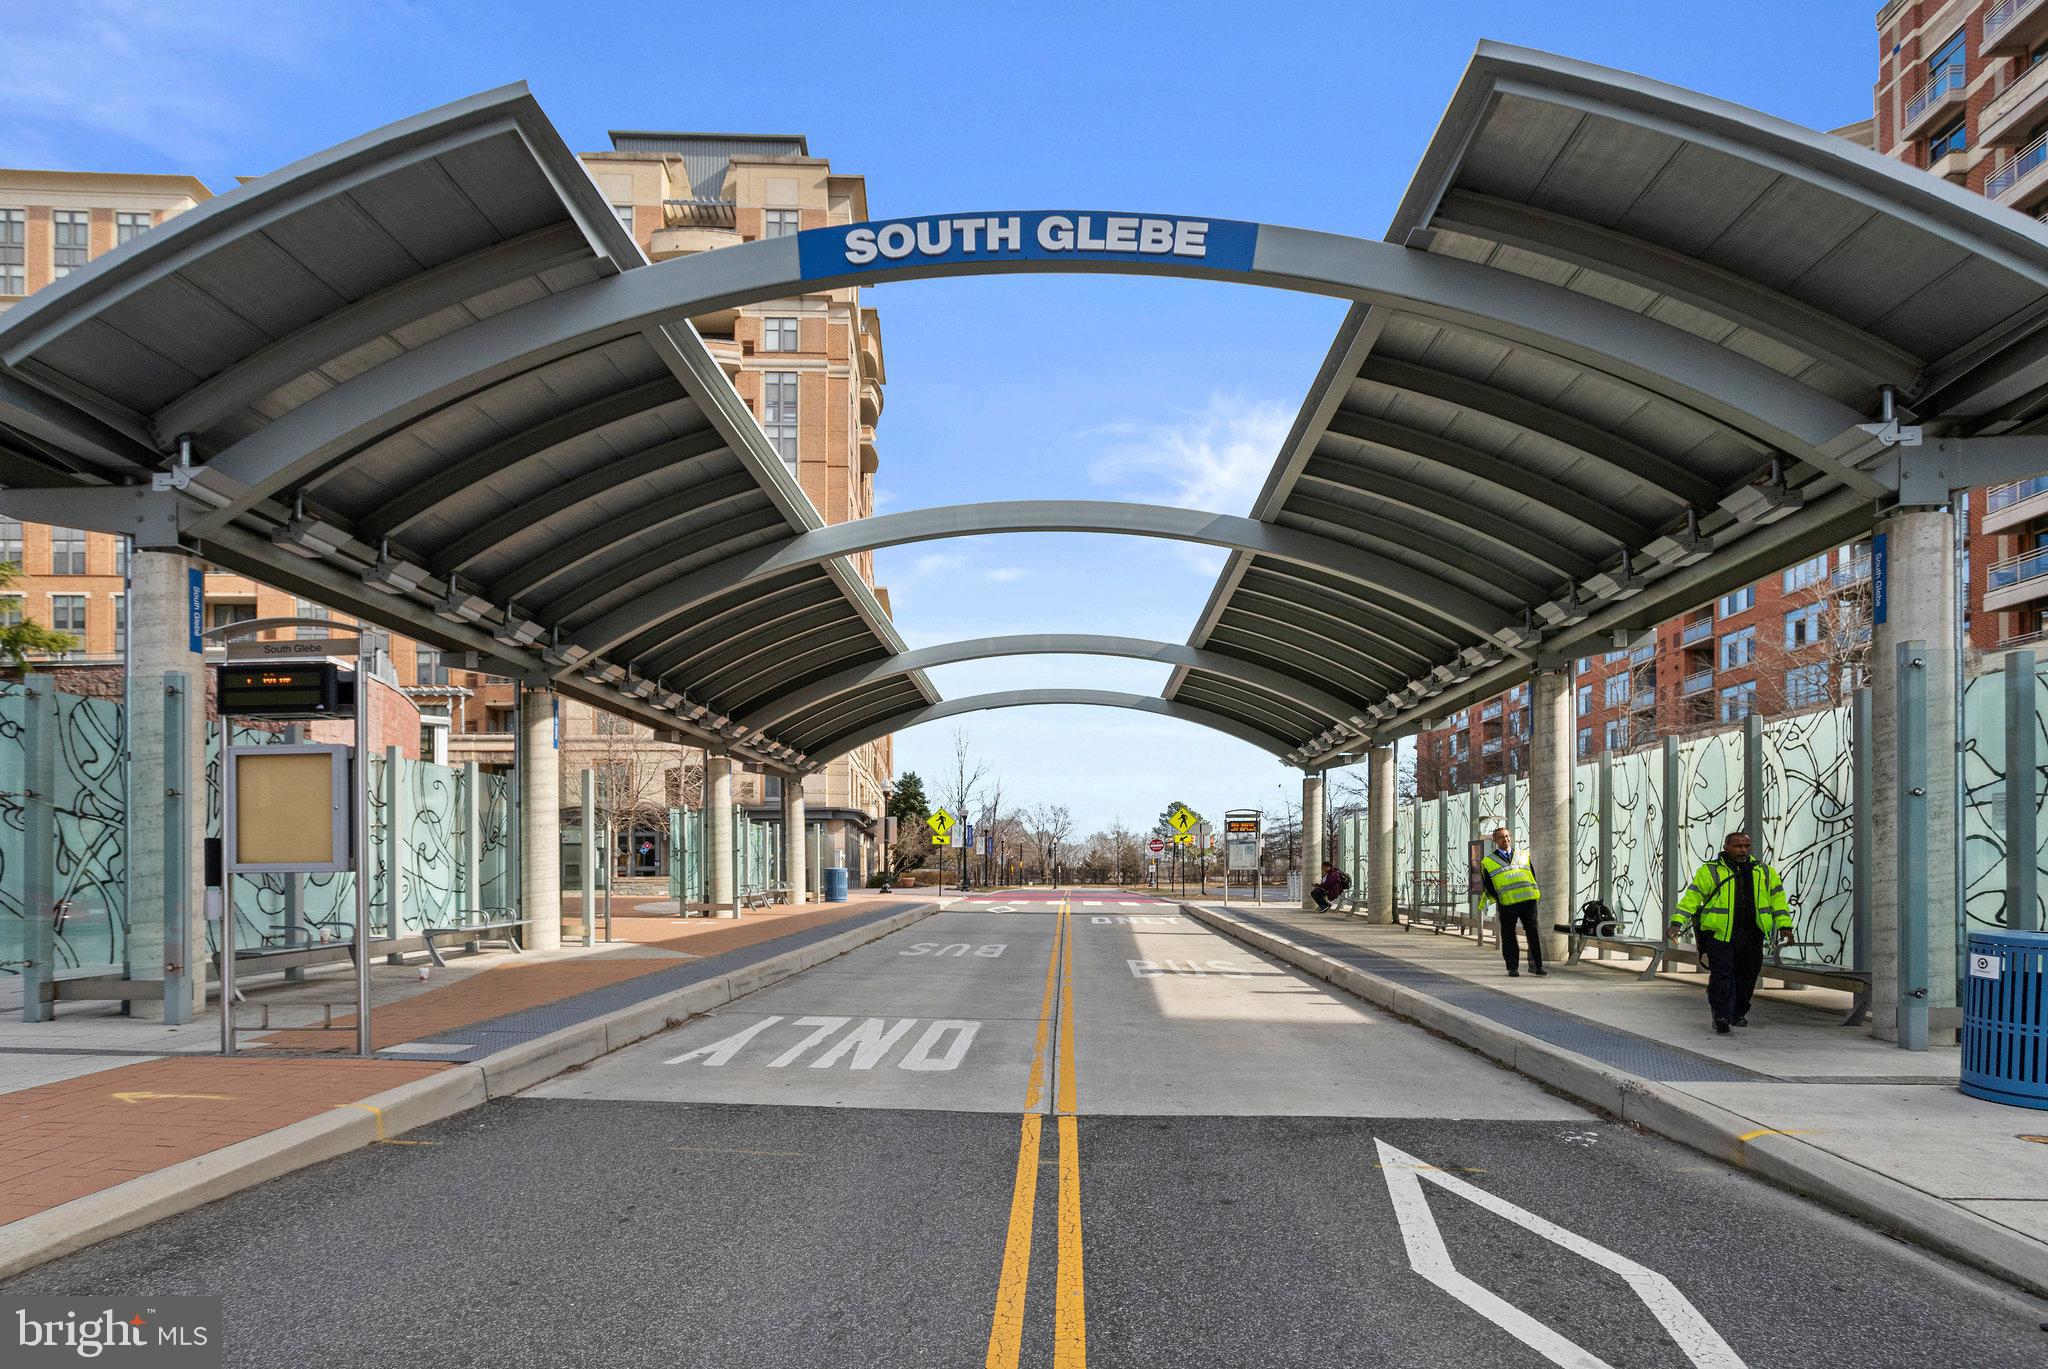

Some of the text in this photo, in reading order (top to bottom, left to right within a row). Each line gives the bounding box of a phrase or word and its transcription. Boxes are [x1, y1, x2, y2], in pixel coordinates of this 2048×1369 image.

[844, 216, 1209, 265] SOUTH GLEBE
[1875, 552, 1883, 607] South Glebe
[264, 643, 322, 654] South Glebe
[1091, 916, 1179, 925] ONLY
[899, 942, 1008, 958] BUS
[1126, 959, 1254, 979] BUS
[662, 1015, 982, 1071] ONLY
